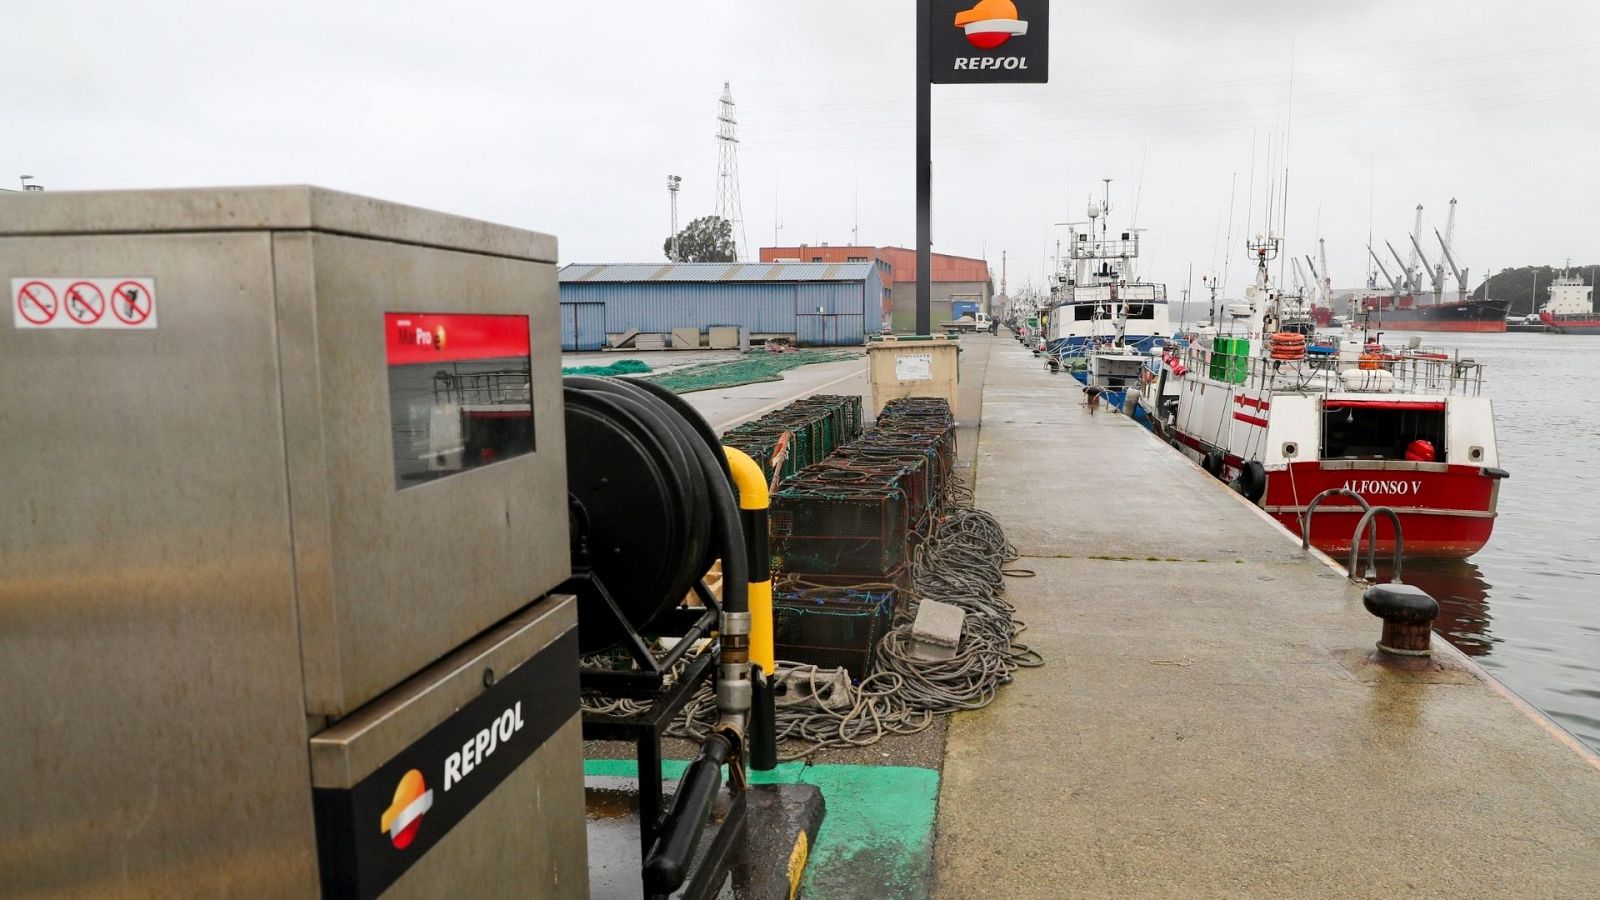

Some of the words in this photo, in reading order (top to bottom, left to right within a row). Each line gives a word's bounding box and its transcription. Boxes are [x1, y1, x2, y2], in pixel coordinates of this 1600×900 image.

[953, 56, 1028, 70] REPSOL
[1341, 480, 1409, 495] ALFONSO
[1411, 481, 1422, 495] V
[443, 700, 524, 792] REPSOL
